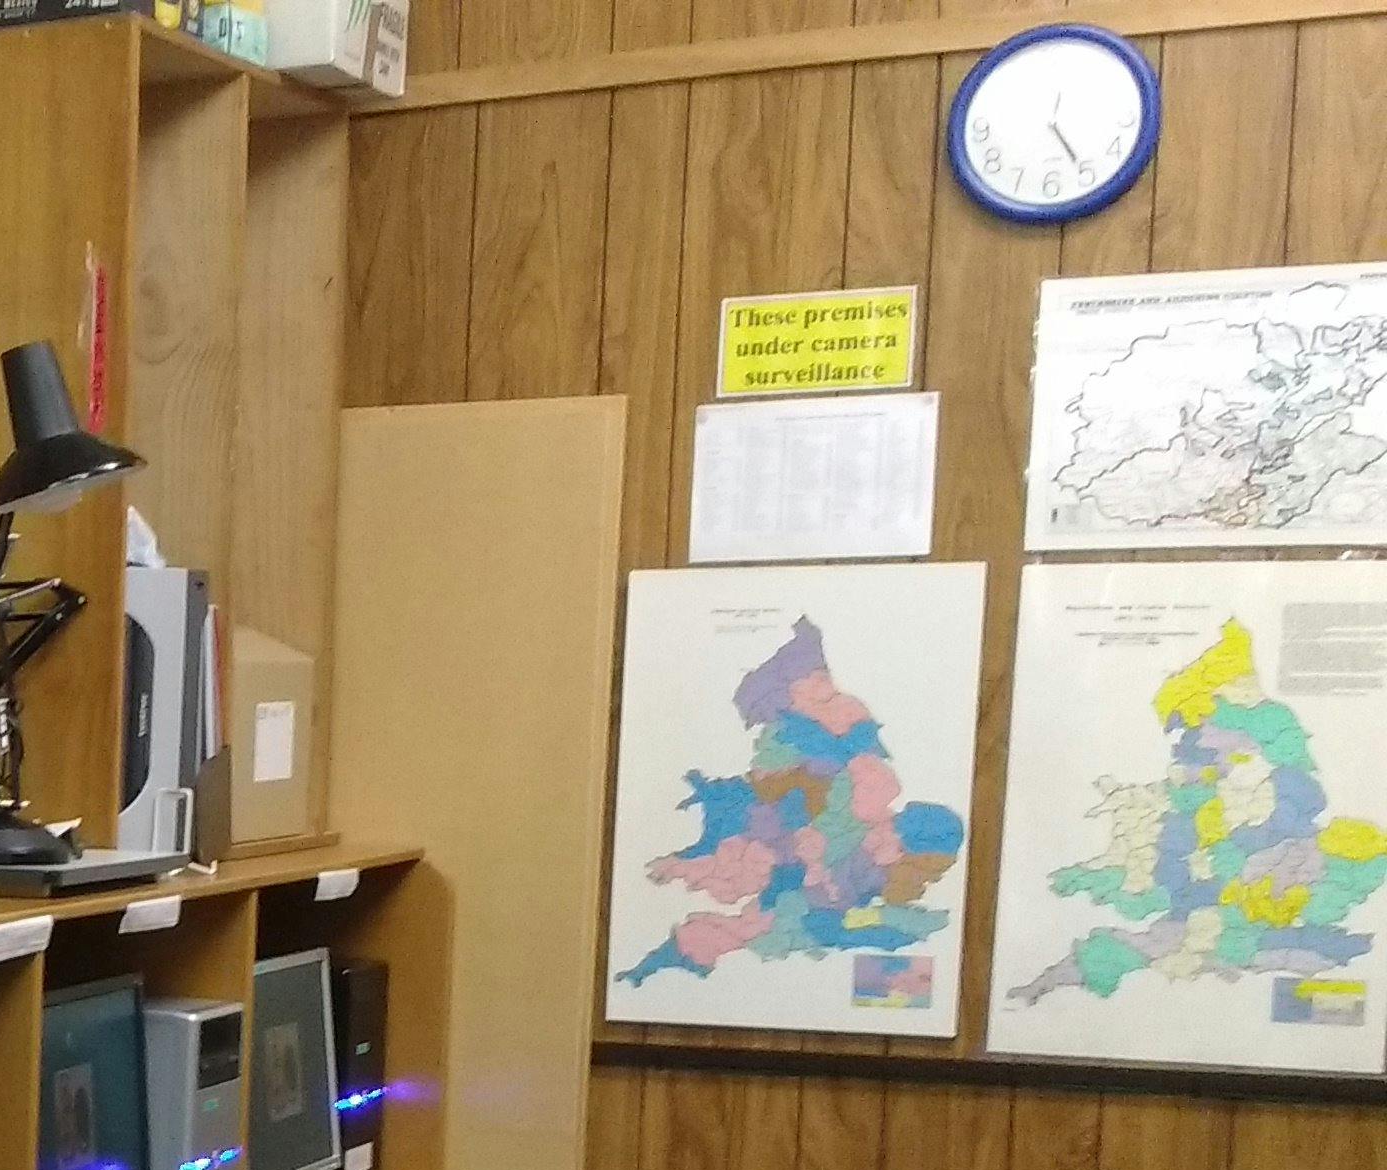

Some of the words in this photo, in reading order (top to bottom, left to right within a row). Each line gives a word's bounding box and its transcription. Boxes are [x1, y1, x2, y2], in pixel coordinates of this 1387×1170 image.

[971, 116, 991, 144] 9
[983, 147, 1002, 174] 8
[1105, 134, 1123, 161] 4
[1009, 166, 1025, 195] 7
[1041, 169, 1061, 199] 6
[1077, 159, 1096, 187] 5
[730, 307, 797, 329] These
[803, 300, 909, 330] premises
[735, 335, 805, 358] under
[810, 332, 898, 353] camera
[743, 362, 886, 387] surveillance
